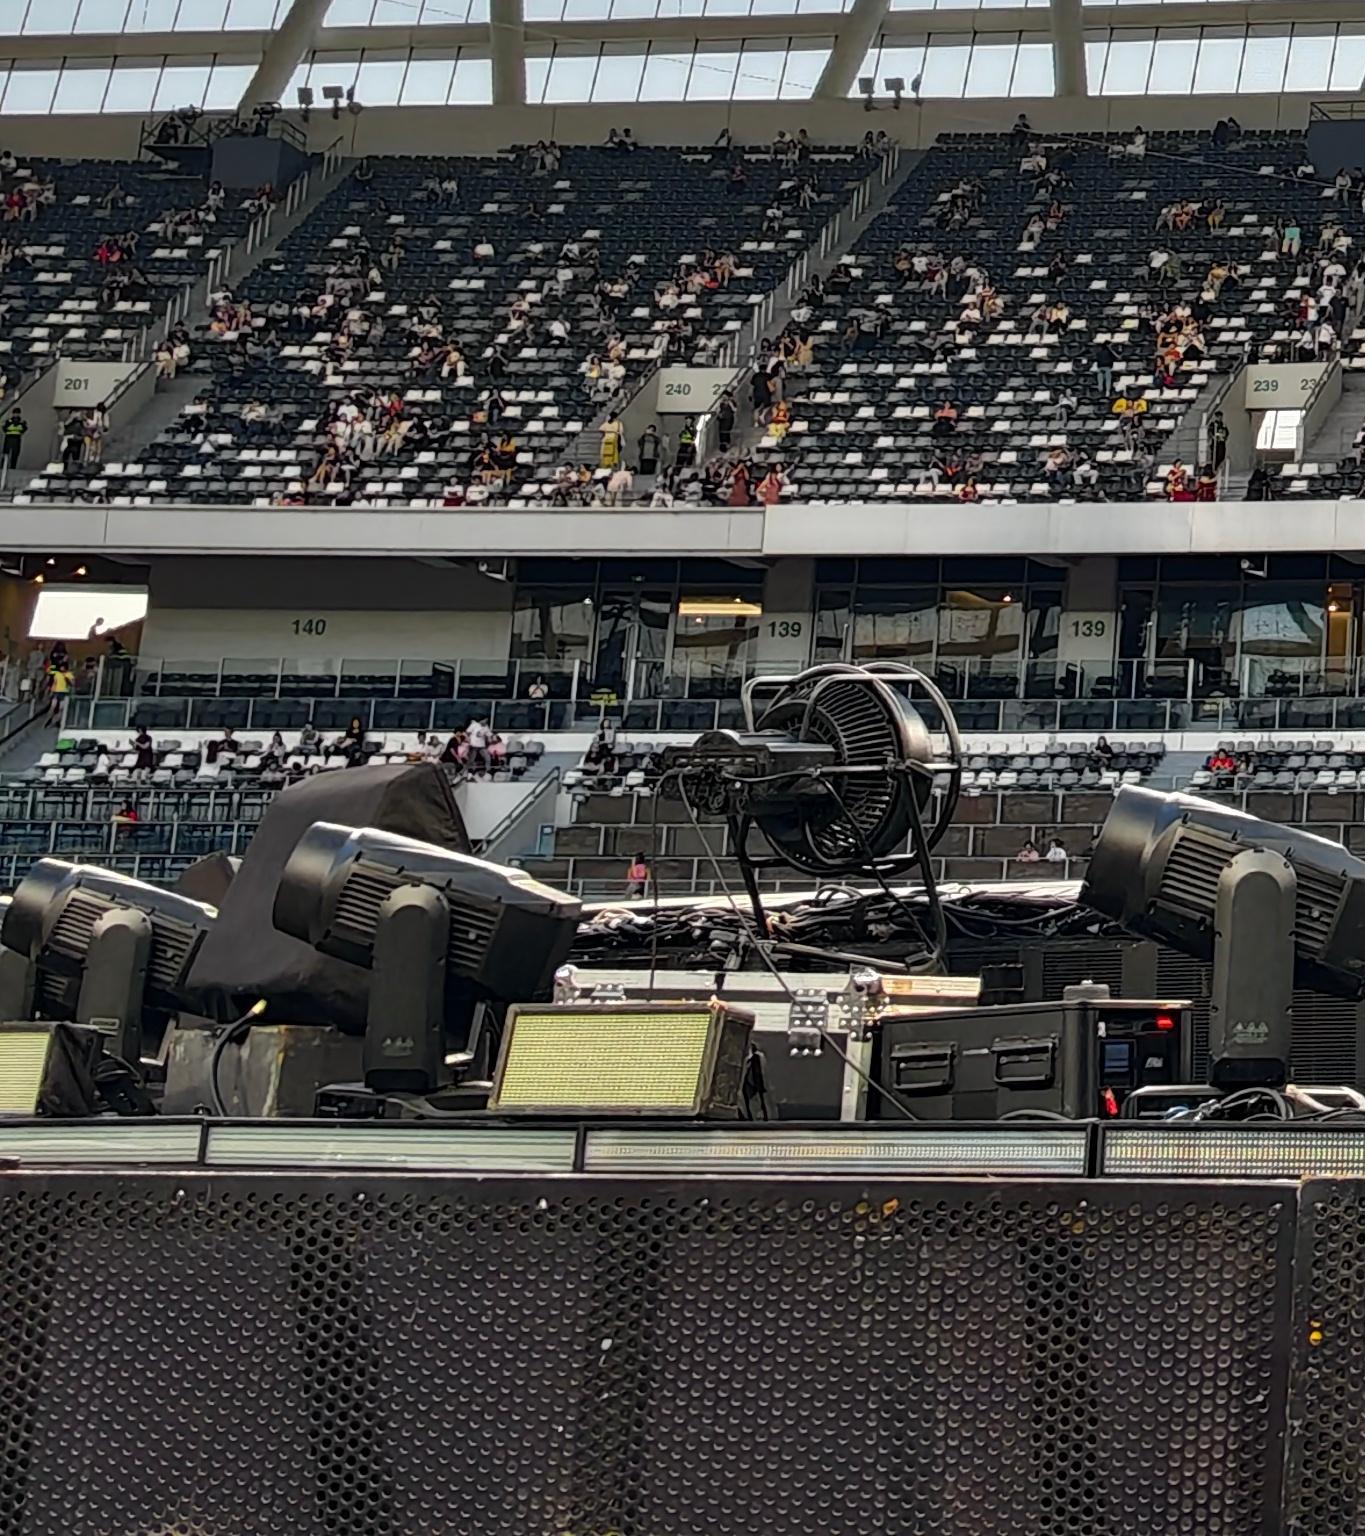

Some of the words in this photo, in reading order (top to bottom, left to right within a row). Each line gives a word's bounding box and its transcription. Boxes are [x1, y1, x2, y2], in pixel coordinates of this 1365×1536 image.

[64, 378, 89, 391] 201
[665, 383, 691, 396] 240
[1253, 380, 1279, 392] 239
[291, 619, 327, 636] 140
[768, 621, 802, 638] 139
[1072, 620, 1106, 637] 139
